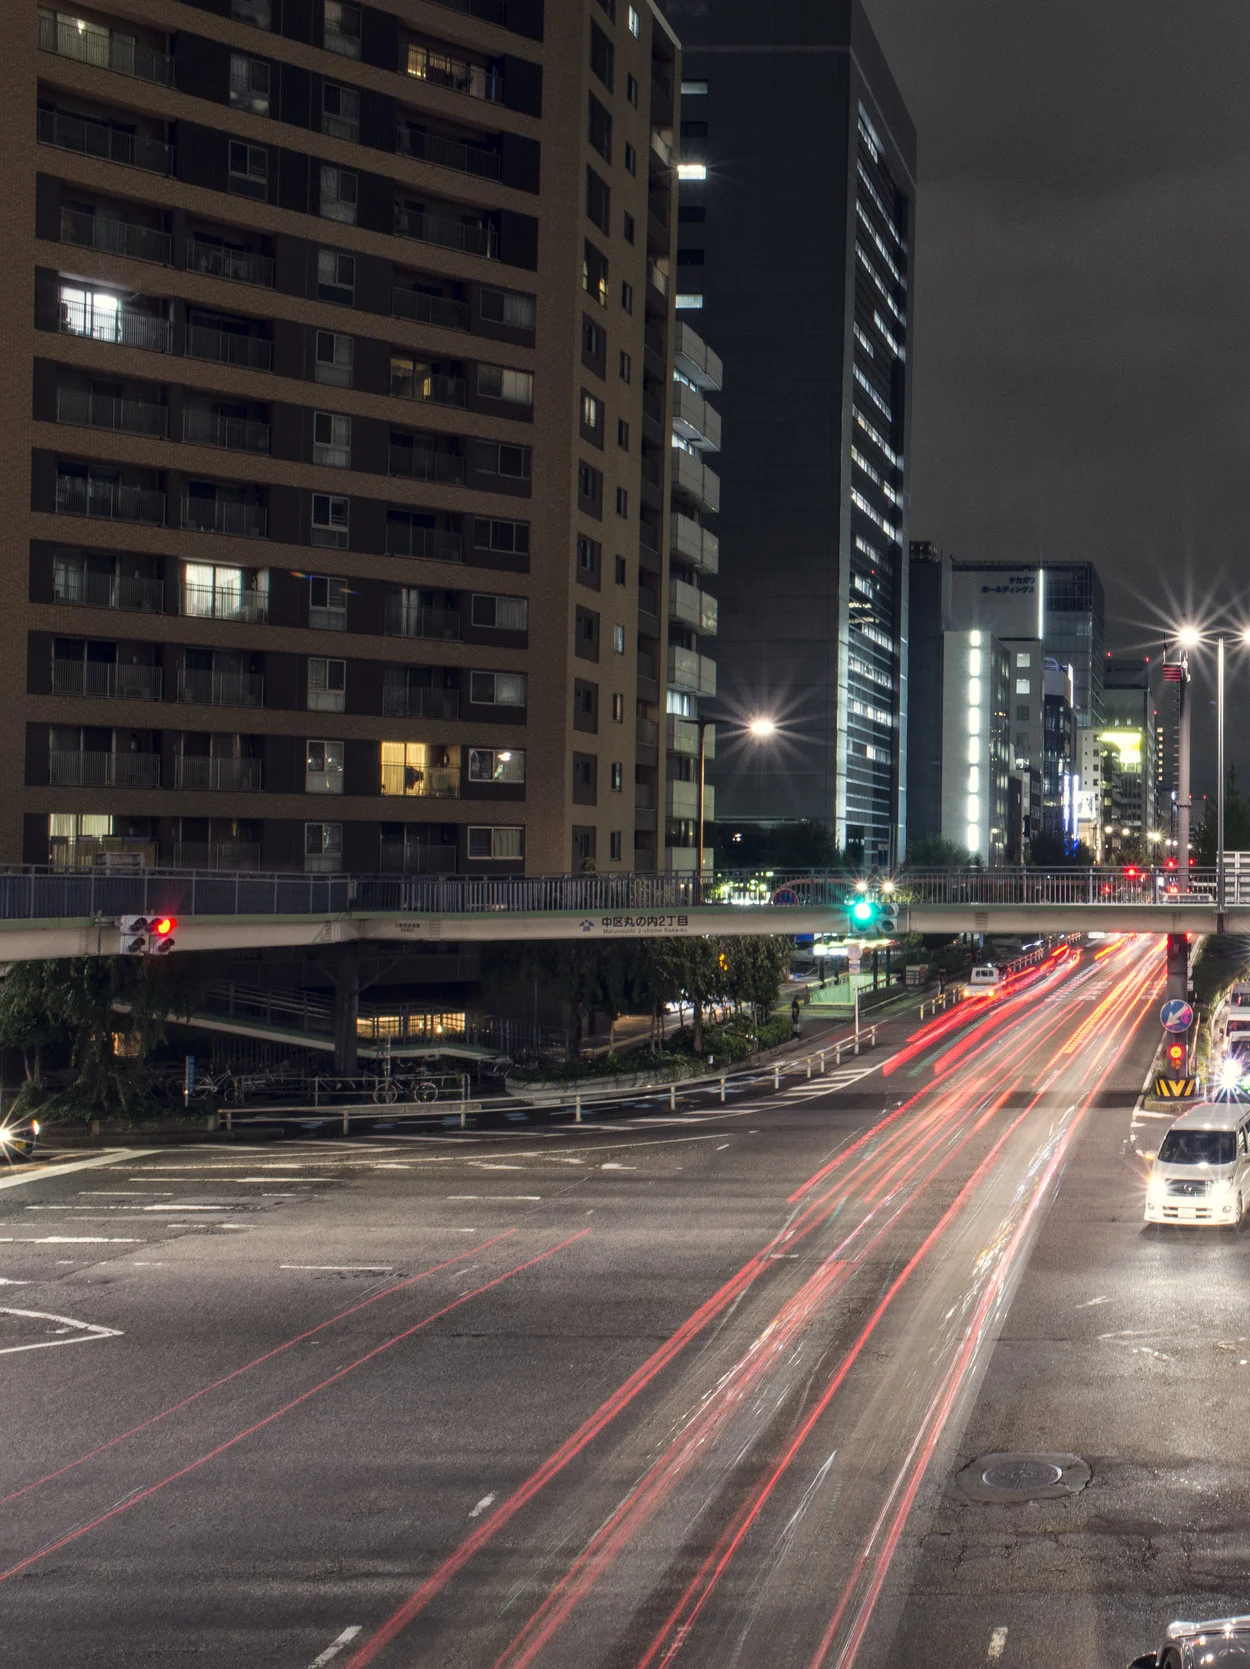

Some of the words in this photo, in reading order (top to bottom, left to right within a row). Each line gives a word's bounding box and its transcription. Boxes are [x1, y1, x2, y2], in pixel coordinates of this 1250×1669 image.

[601, 915, 688, 928] 中区丸の内2丁目
